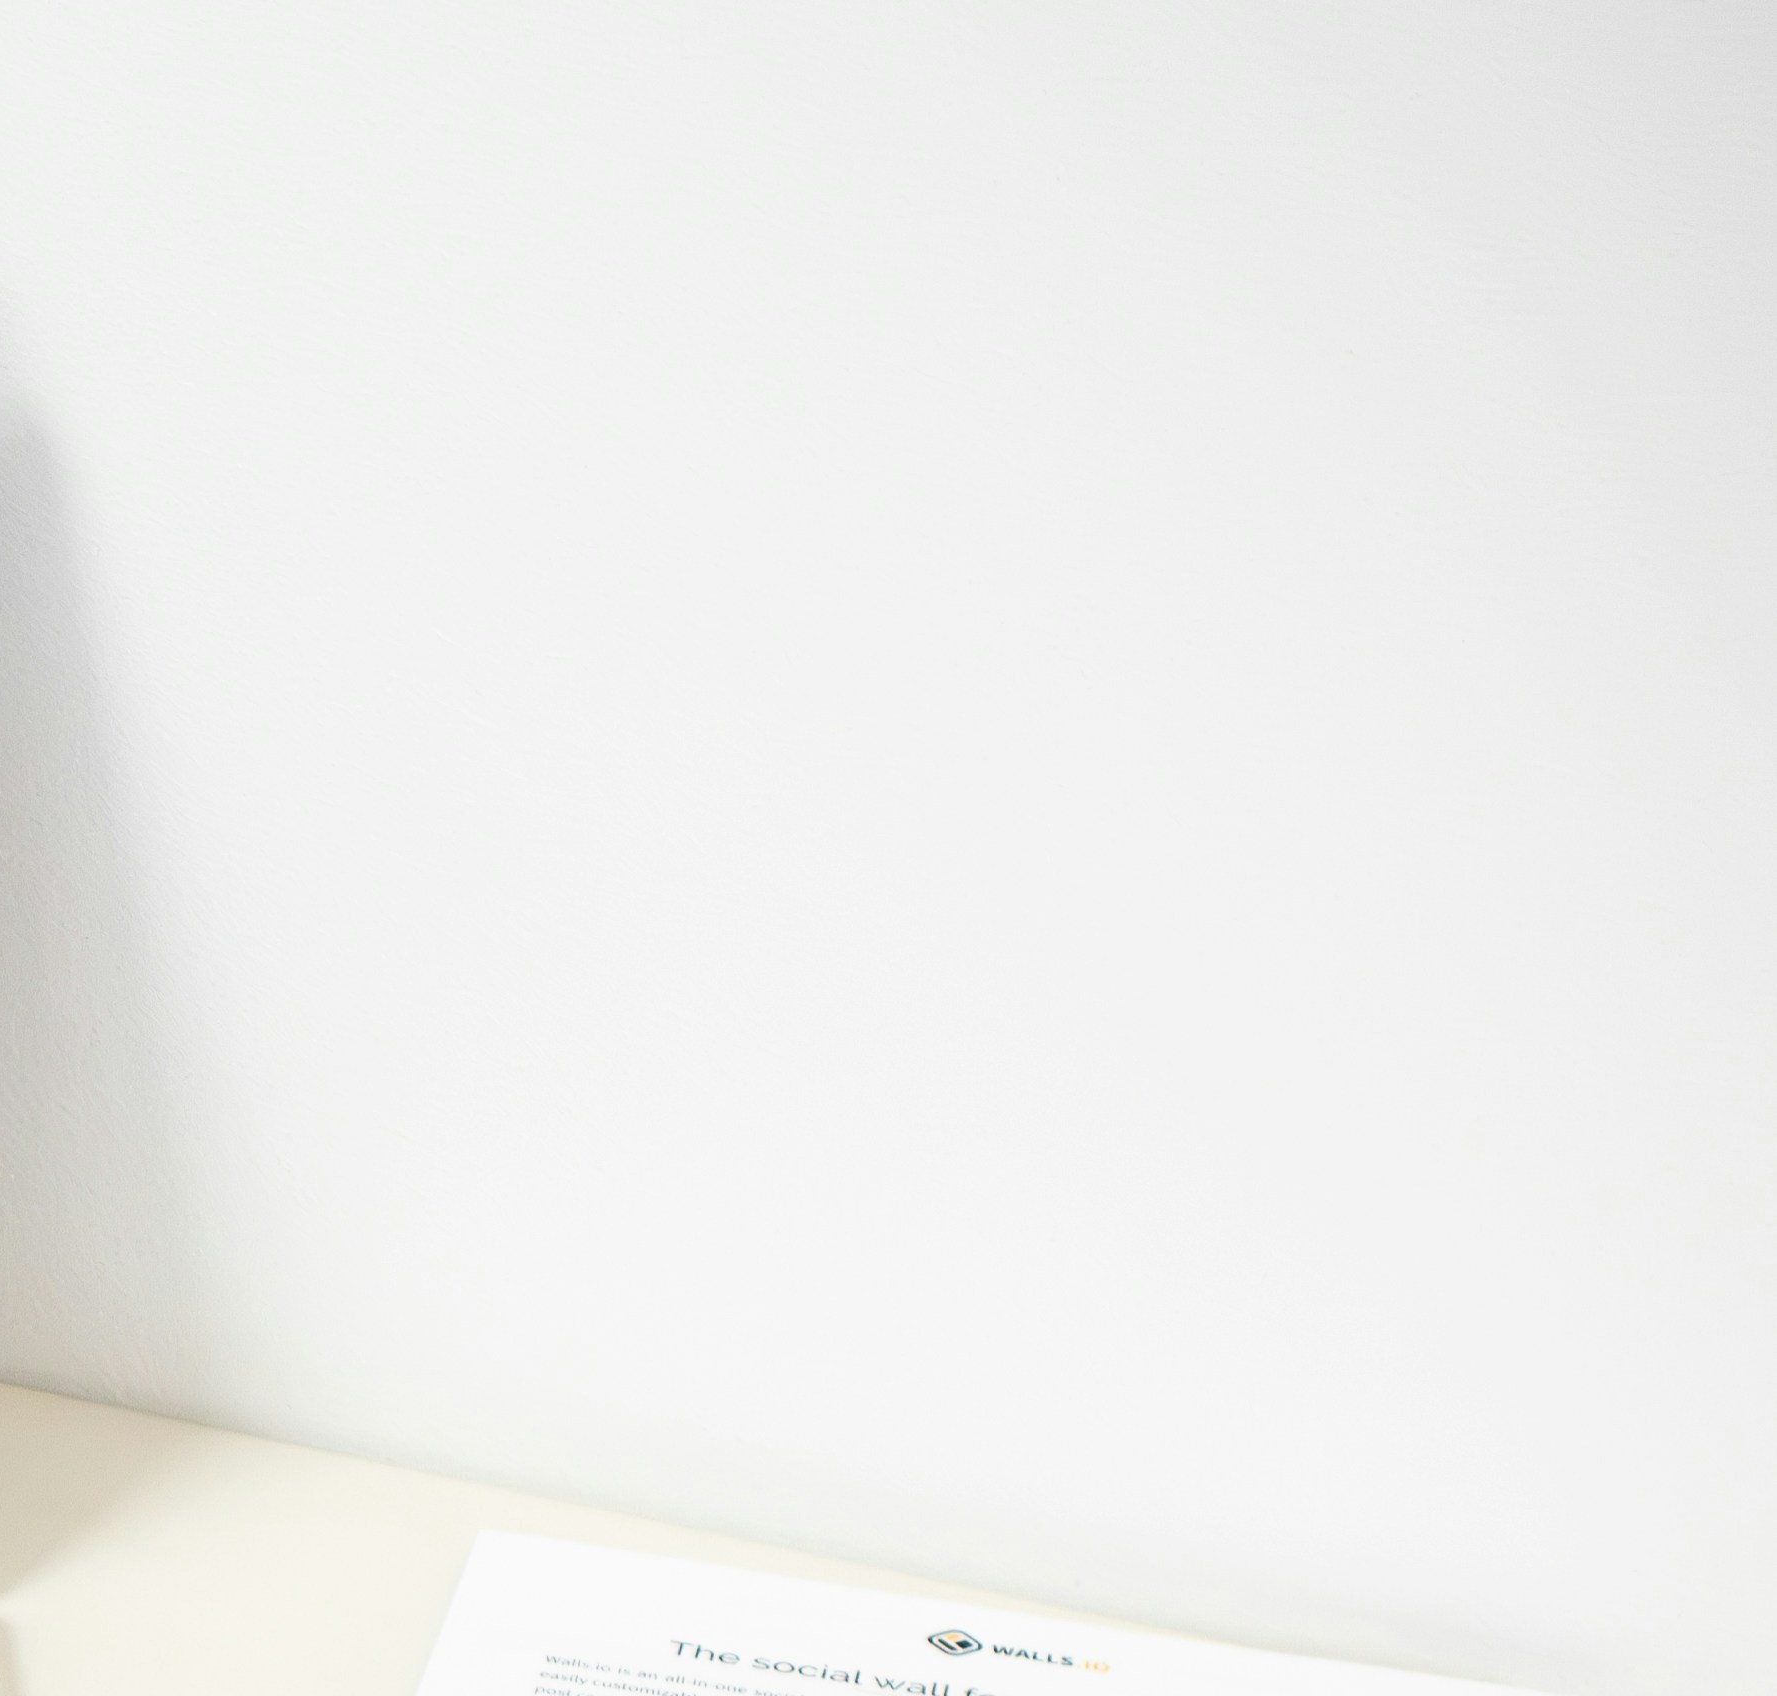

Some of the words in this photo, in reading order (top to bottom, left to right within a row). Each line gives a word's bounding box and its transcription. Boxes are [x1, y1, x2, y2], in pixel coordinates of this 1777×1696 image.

[669, 1640, 741, 1665] The
[753, 1656, 861, 1685] social
[993, 1644, 1110, 1673] WALLS.IO
